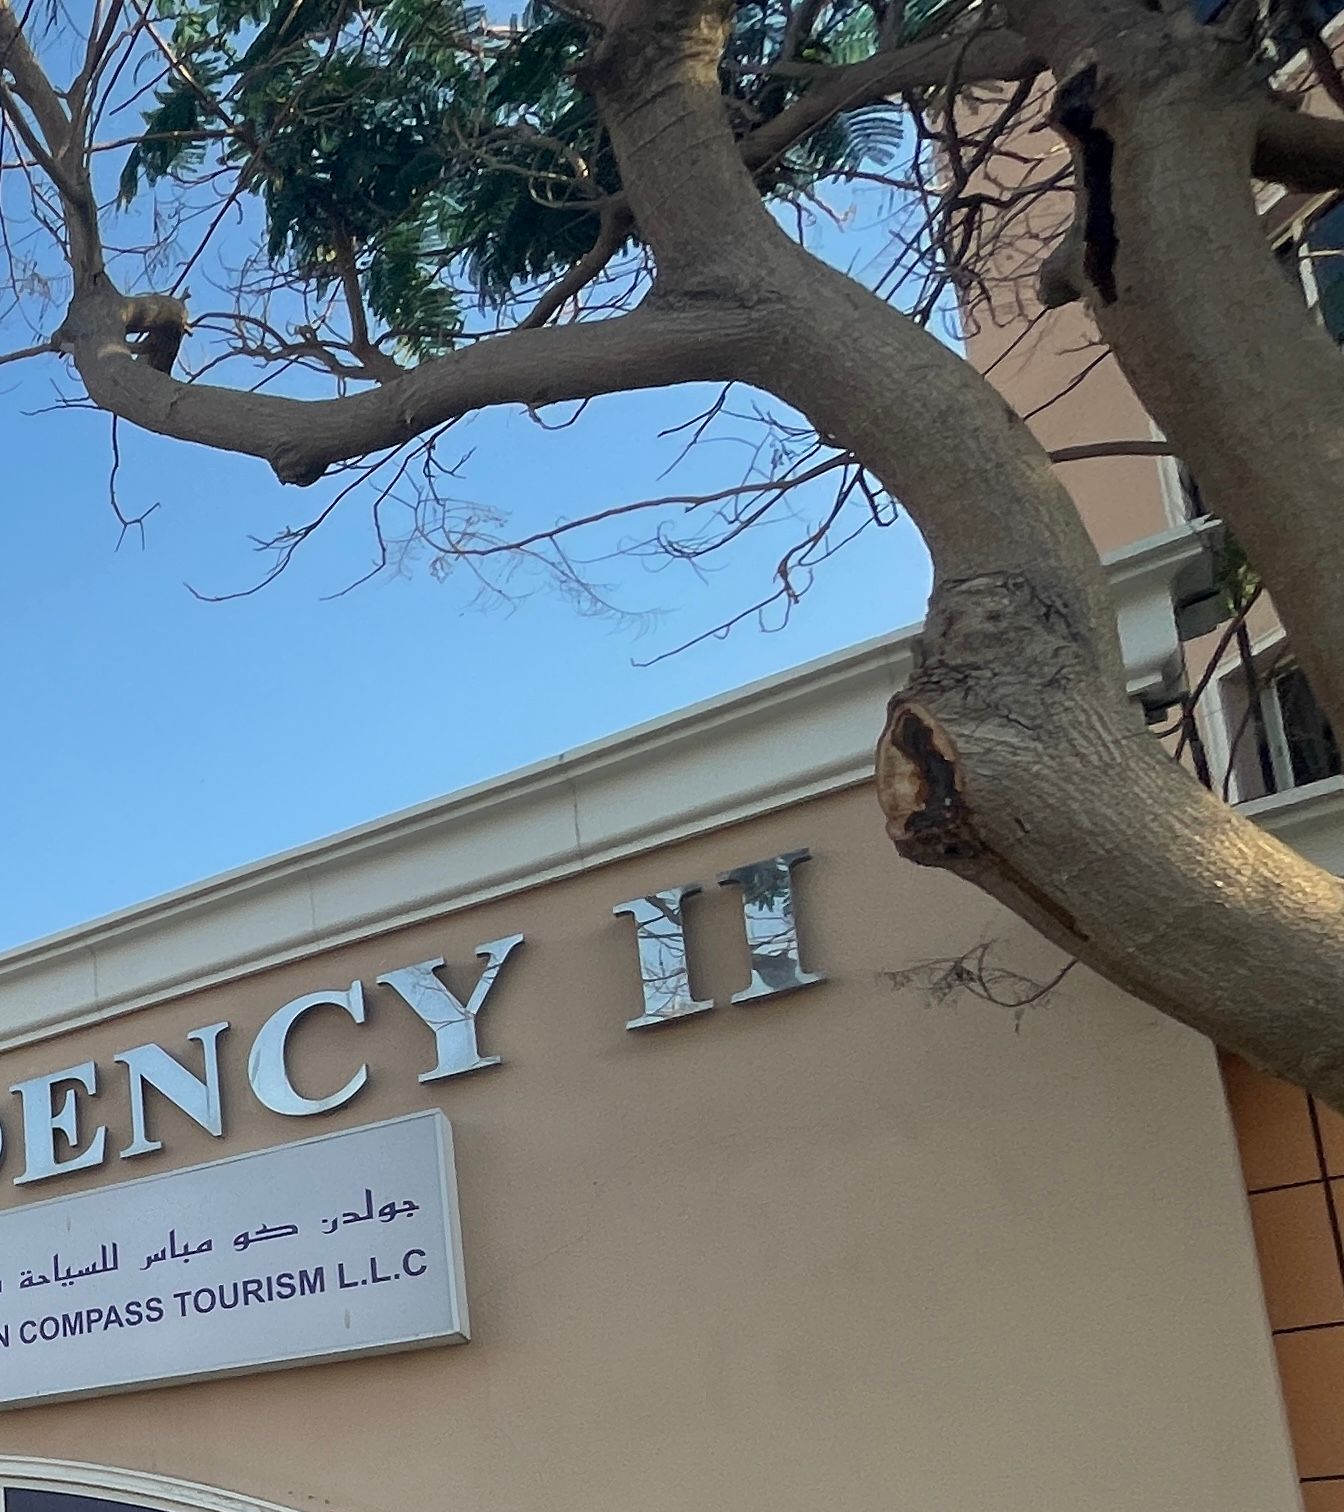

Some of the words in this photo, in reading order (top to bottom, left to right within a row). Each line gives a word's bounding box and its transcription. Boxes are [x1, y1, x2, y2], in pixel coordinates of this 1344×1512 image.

[613, 848, 829, 1031] II
[18, 1296, 164, 1345] COMPASS
[172, 1266, 326, 1317] TOURISM
[338, 1248, 428, 1289] L.L.C
[19, 1241, 119, 1291] للسياحة
